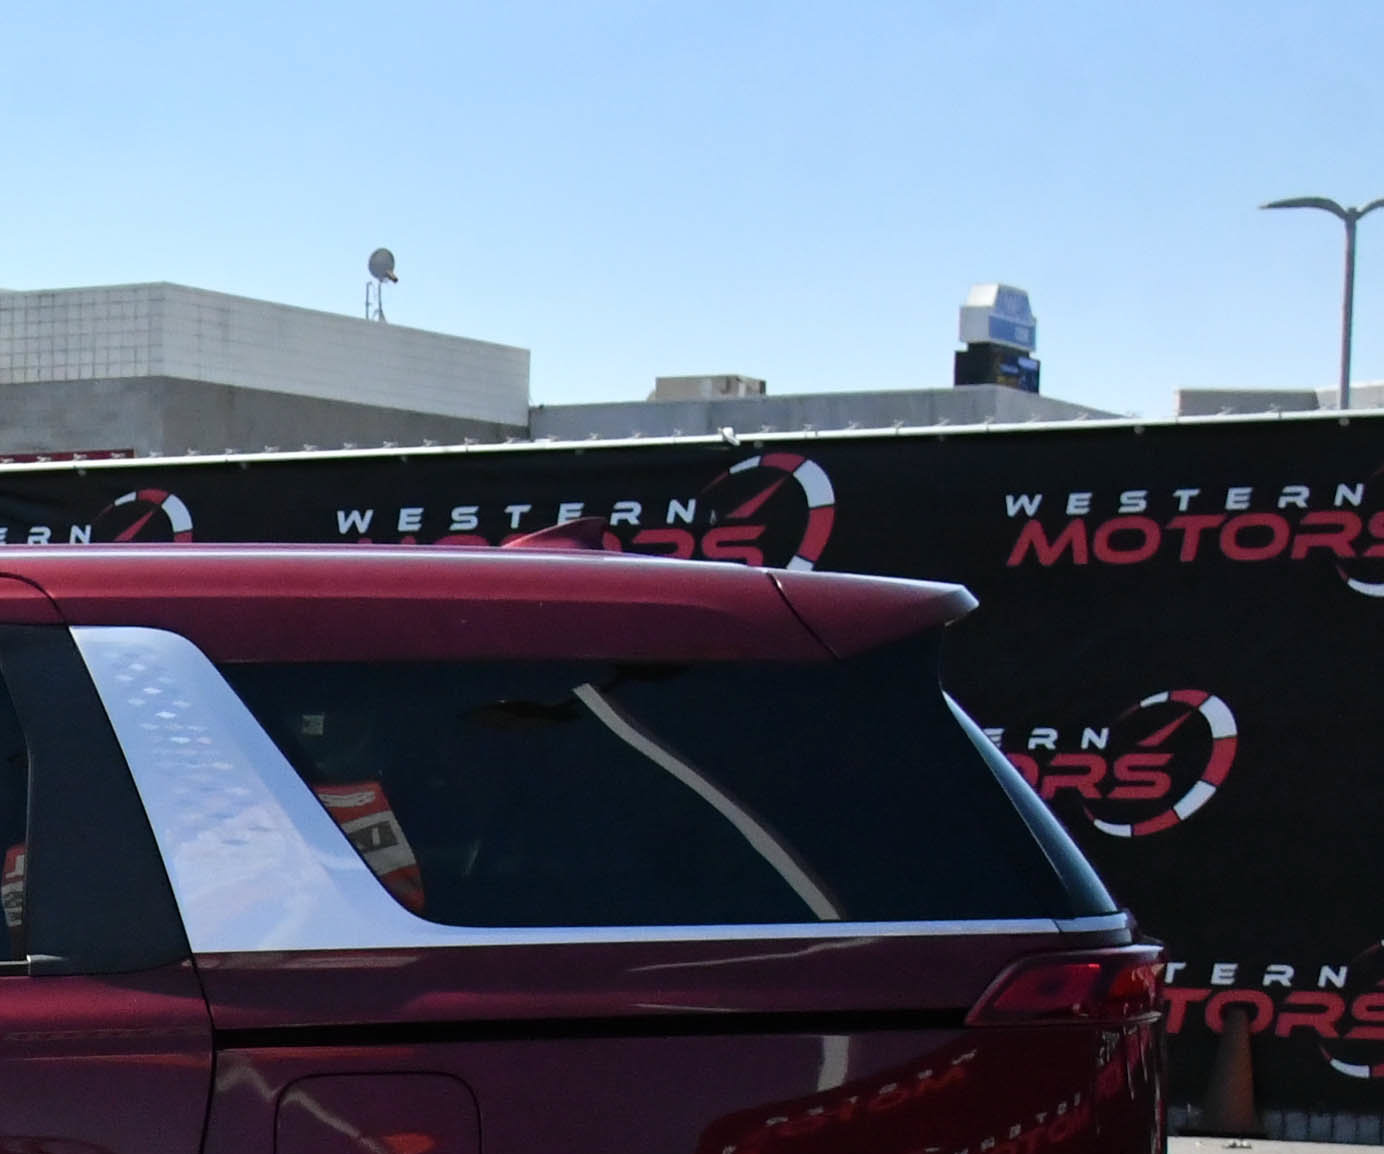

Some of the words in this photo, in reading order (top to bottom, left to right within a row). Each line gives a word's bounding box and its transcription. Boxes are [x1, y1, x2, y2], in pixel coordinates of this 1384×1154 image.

[337, 499, 697, 536] WESTERN
[1005, 483, 1364, 518] WESTERN
[1164, 962, 1348, 988] TERN
